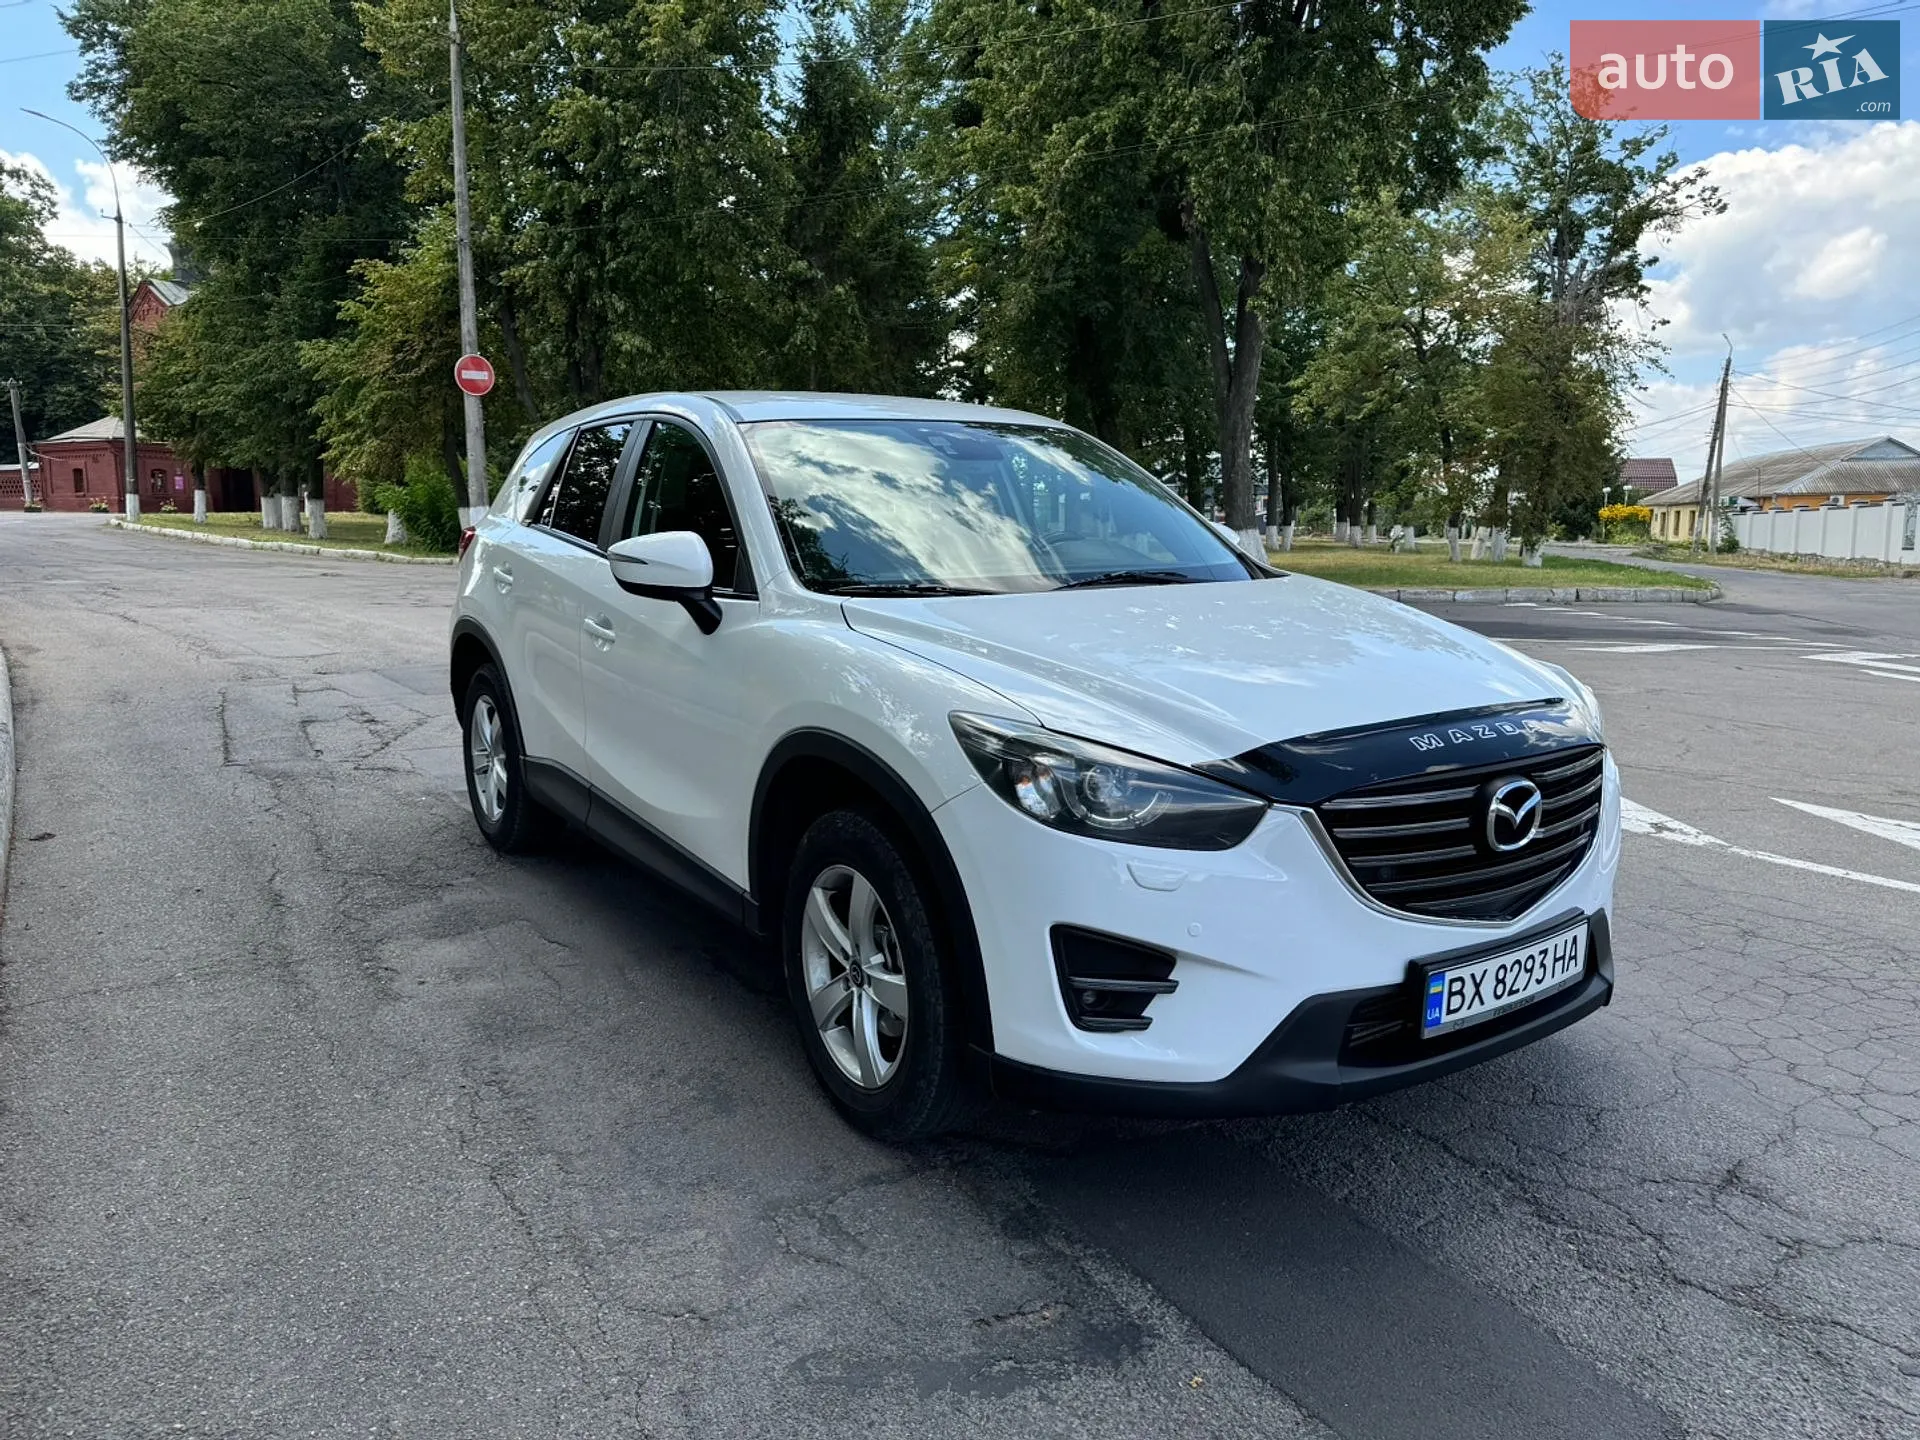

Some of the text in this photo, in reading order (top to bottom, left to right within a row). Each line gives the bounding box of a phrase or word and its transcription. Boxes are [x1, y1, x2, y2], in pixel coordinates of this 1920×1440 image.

[1446, 968, 1488, 1016] BX
[1493, 947, 1549, 1001] 8293
[1551, 934, 1578, 979] HA
[1427, 1007, 1440, 1020] UA
